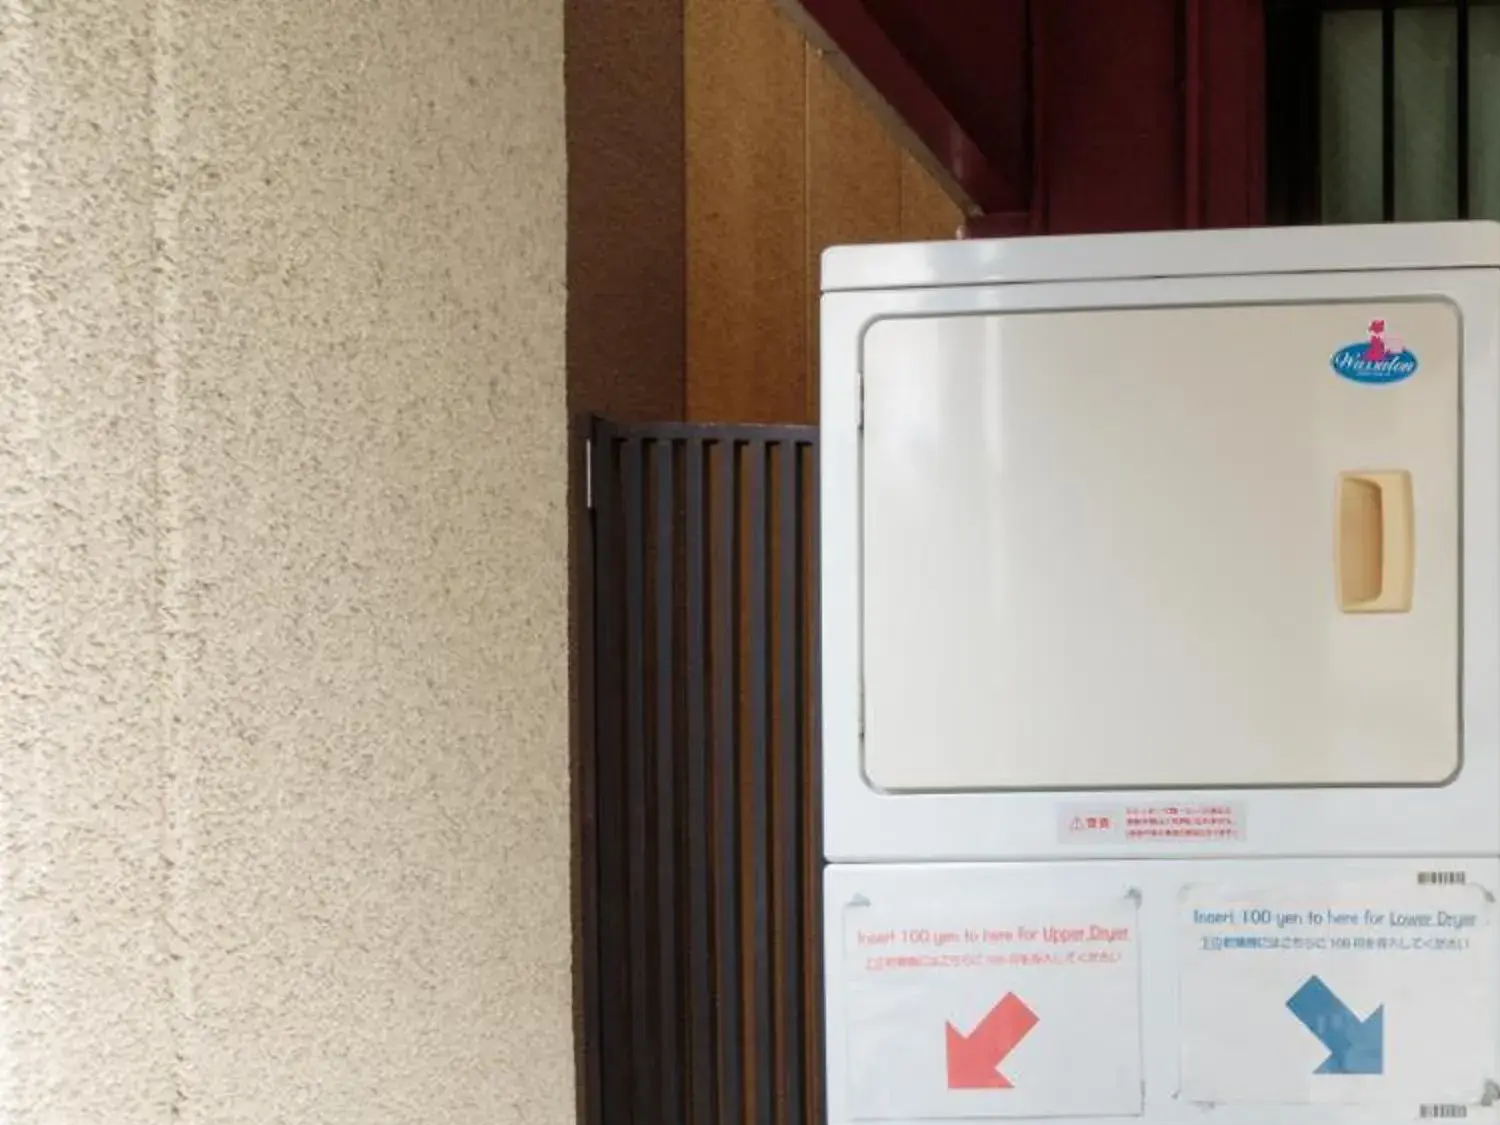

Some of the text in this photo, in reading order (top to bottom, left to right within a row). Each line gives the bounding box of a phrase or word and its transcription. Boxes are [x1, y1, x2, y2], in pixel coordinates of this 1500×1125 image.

[1193, 909, 1235, 925] Insert
[1242, 909, 1272, 925] 100
[1276, 911, 1303, 929] yen
[1308, 910, 1324, 925] to
[1328, 909, 1359, 925] here
[1364, 909, 1386, 925] for
[1389, 910, 1432, 927] Lower
[901, 928, 931, 944] 100
[933, 932, 960, 947] yen
[965, 928, 979, 943] to
[983, 928, 1014, 943] here
[1018, 926, 1039, 941] for
[1042, 926, 1086, 945] Upper
